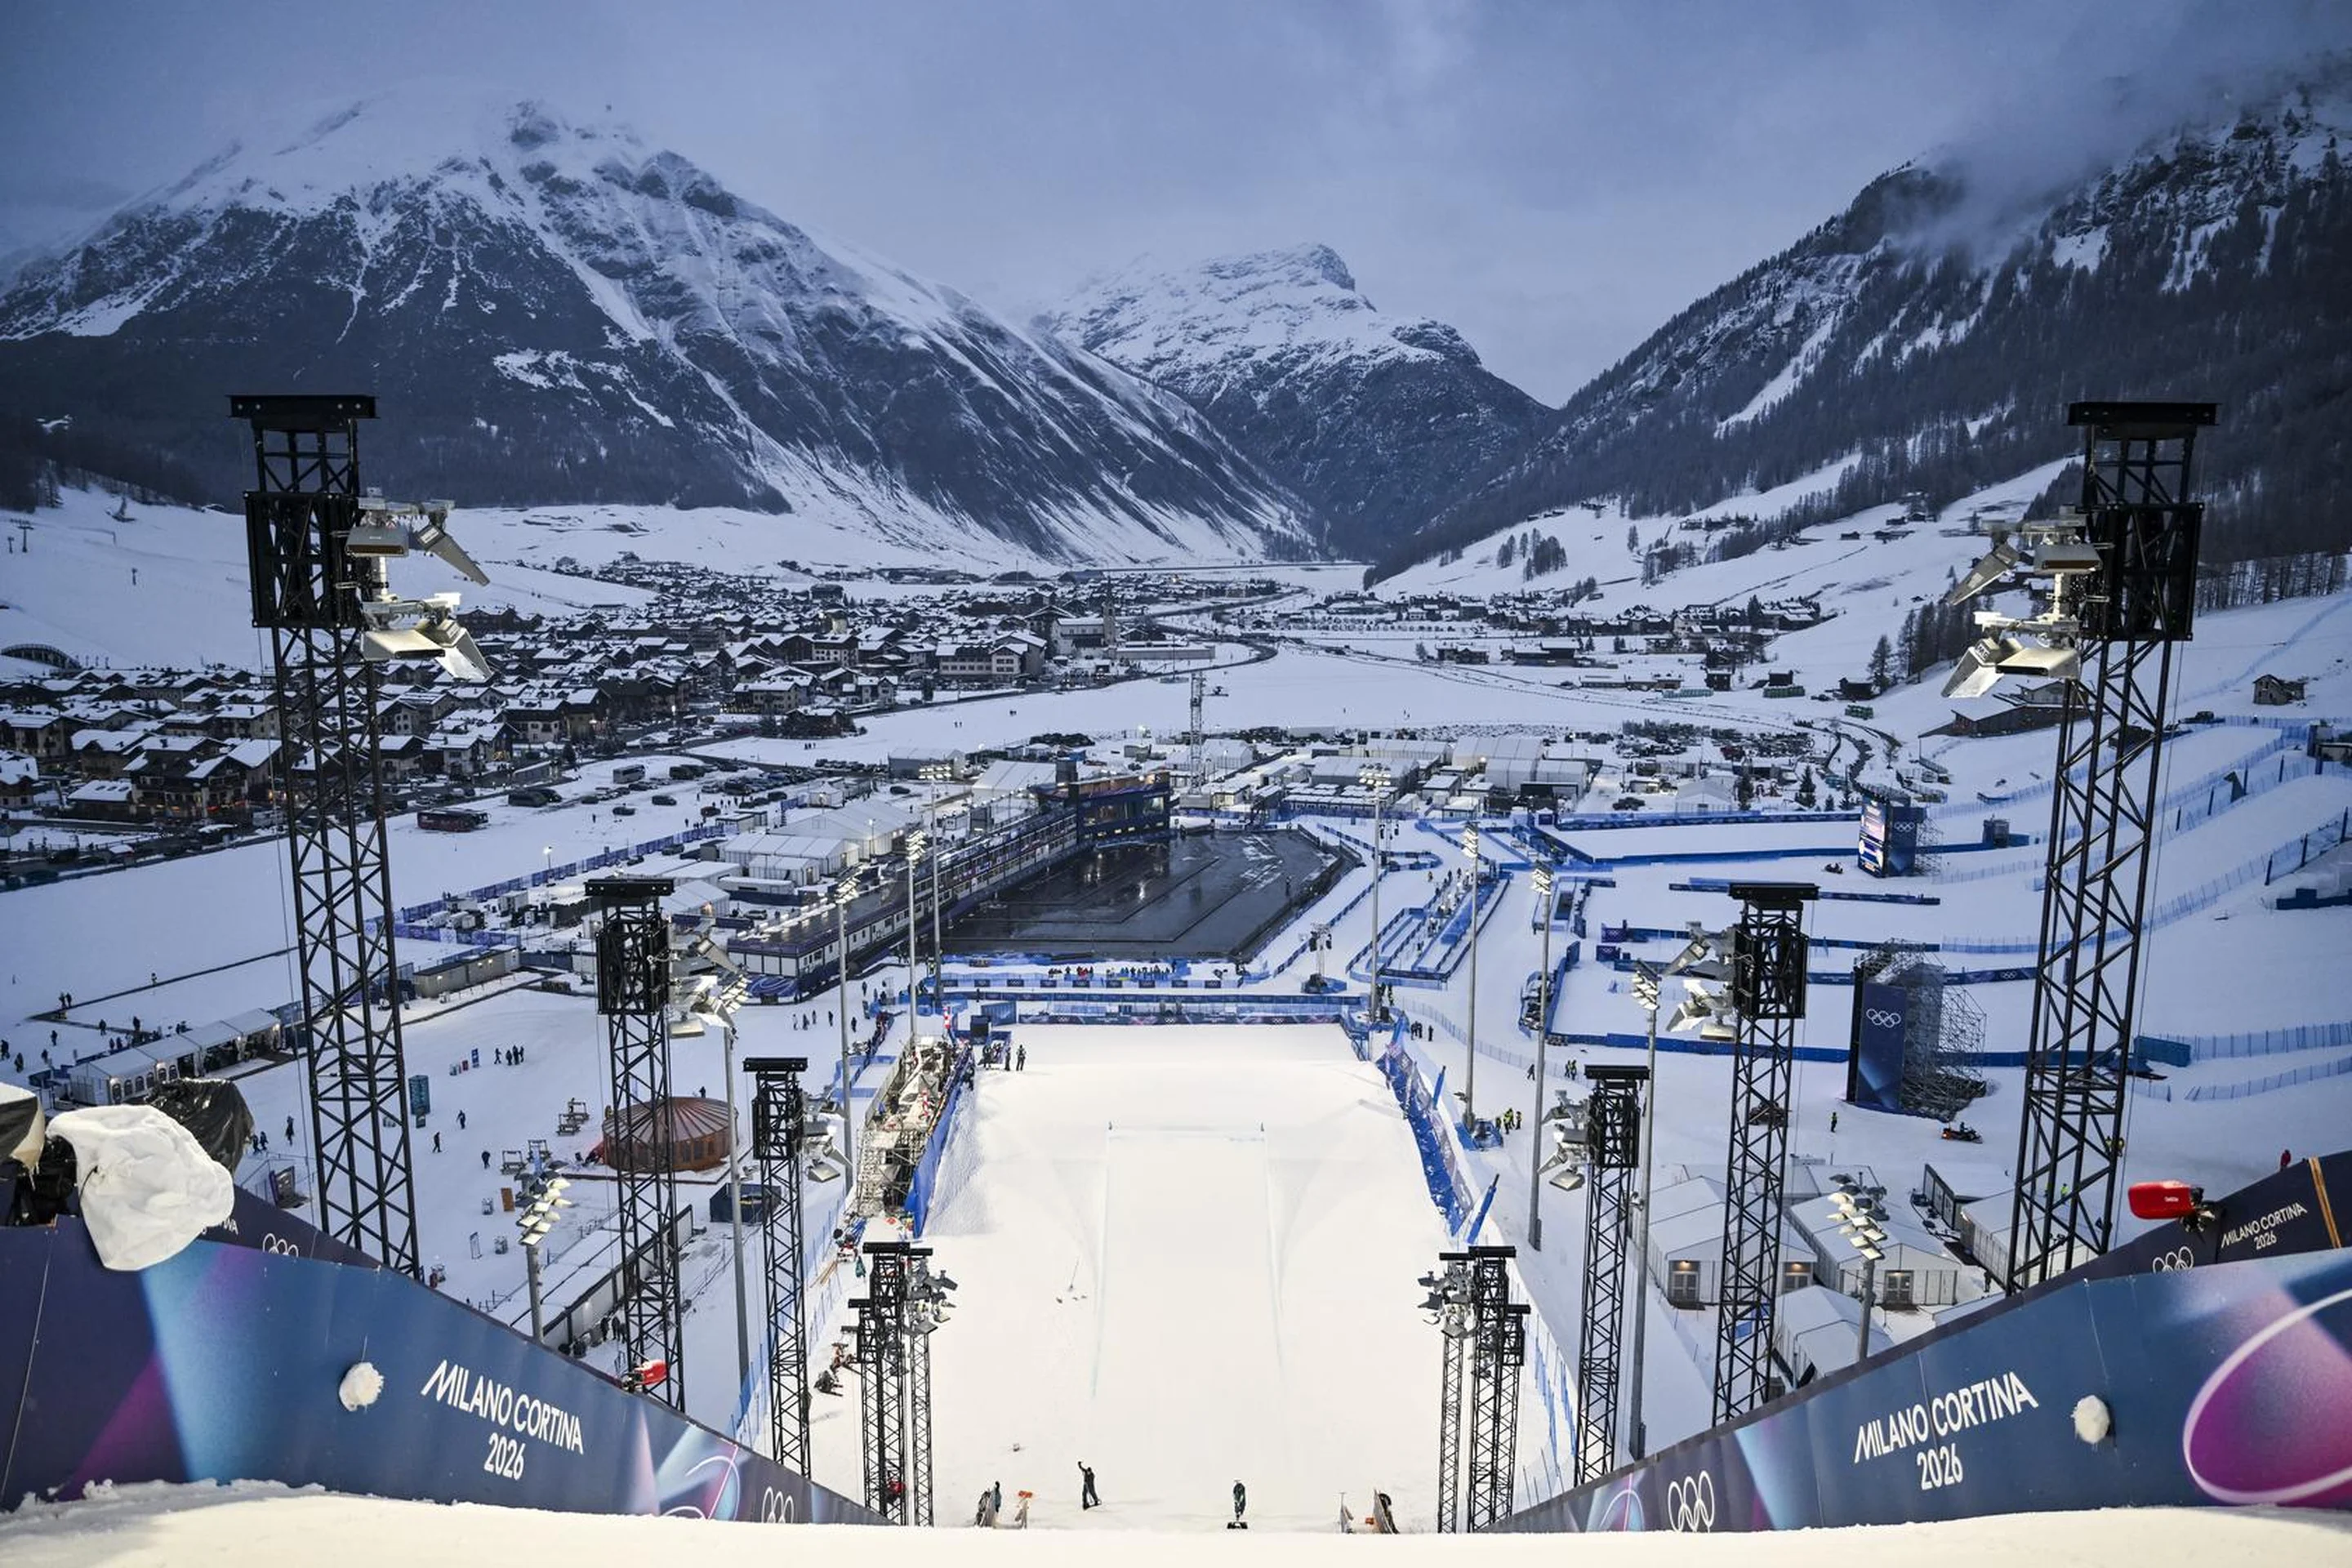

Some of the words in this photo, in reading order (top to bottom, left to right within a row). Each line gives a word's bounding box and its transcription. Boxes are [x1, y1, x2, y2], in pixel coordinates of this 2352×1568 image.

[2221, 1220, 2261, 1248] MILANO
[2260, 1202, 2308, 1230] CORTINA
[2254, 1231, 2277, 1250] 2026
[421, 1360, 512, 1426] MILANO
[514, 1394, 584, 1454] CORTINA
[1854, 1404, 1929, 1463] MILANO
[1931, 1371, 2039, 1437] CORTINA
[483, 1432, 526, 1481] 2026
[1917, 1443, 1963, 1490] 2026
